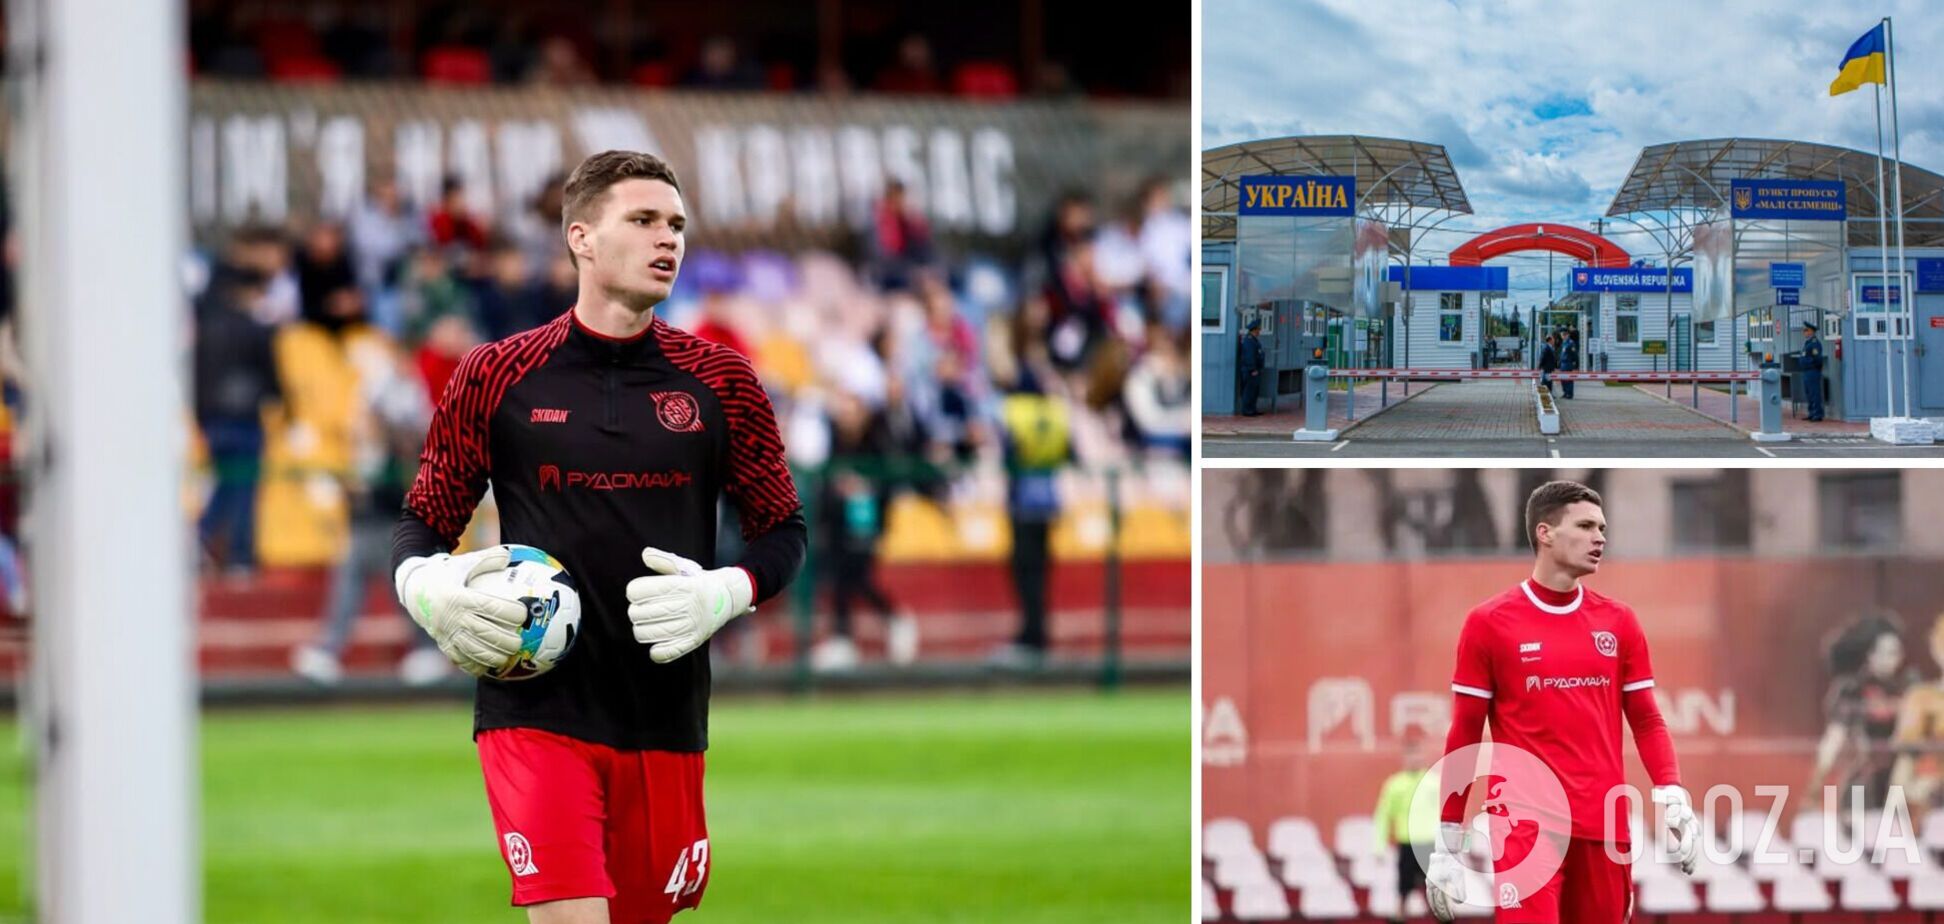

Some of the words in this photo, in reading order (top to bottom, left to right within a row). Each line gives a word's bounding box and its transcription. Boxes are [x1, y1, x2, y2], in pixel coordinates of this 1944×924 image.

[1245, 180, 1348, 208] УКРАЇНА
[1758, 188, 1788, 197] ПУНКТ
[1790, 188, 1838, 198] ПРОПУСКУ
[1593, 273, 1640, 286] SLOVENSKÁ
[530, 408, 568, 423] SKIDAN
[567, 470, 692, 490] РУДОМАЙН
[1543, 676, 1610, 689] РУДОМАЙН
[664, 839, 708, 904] 43
